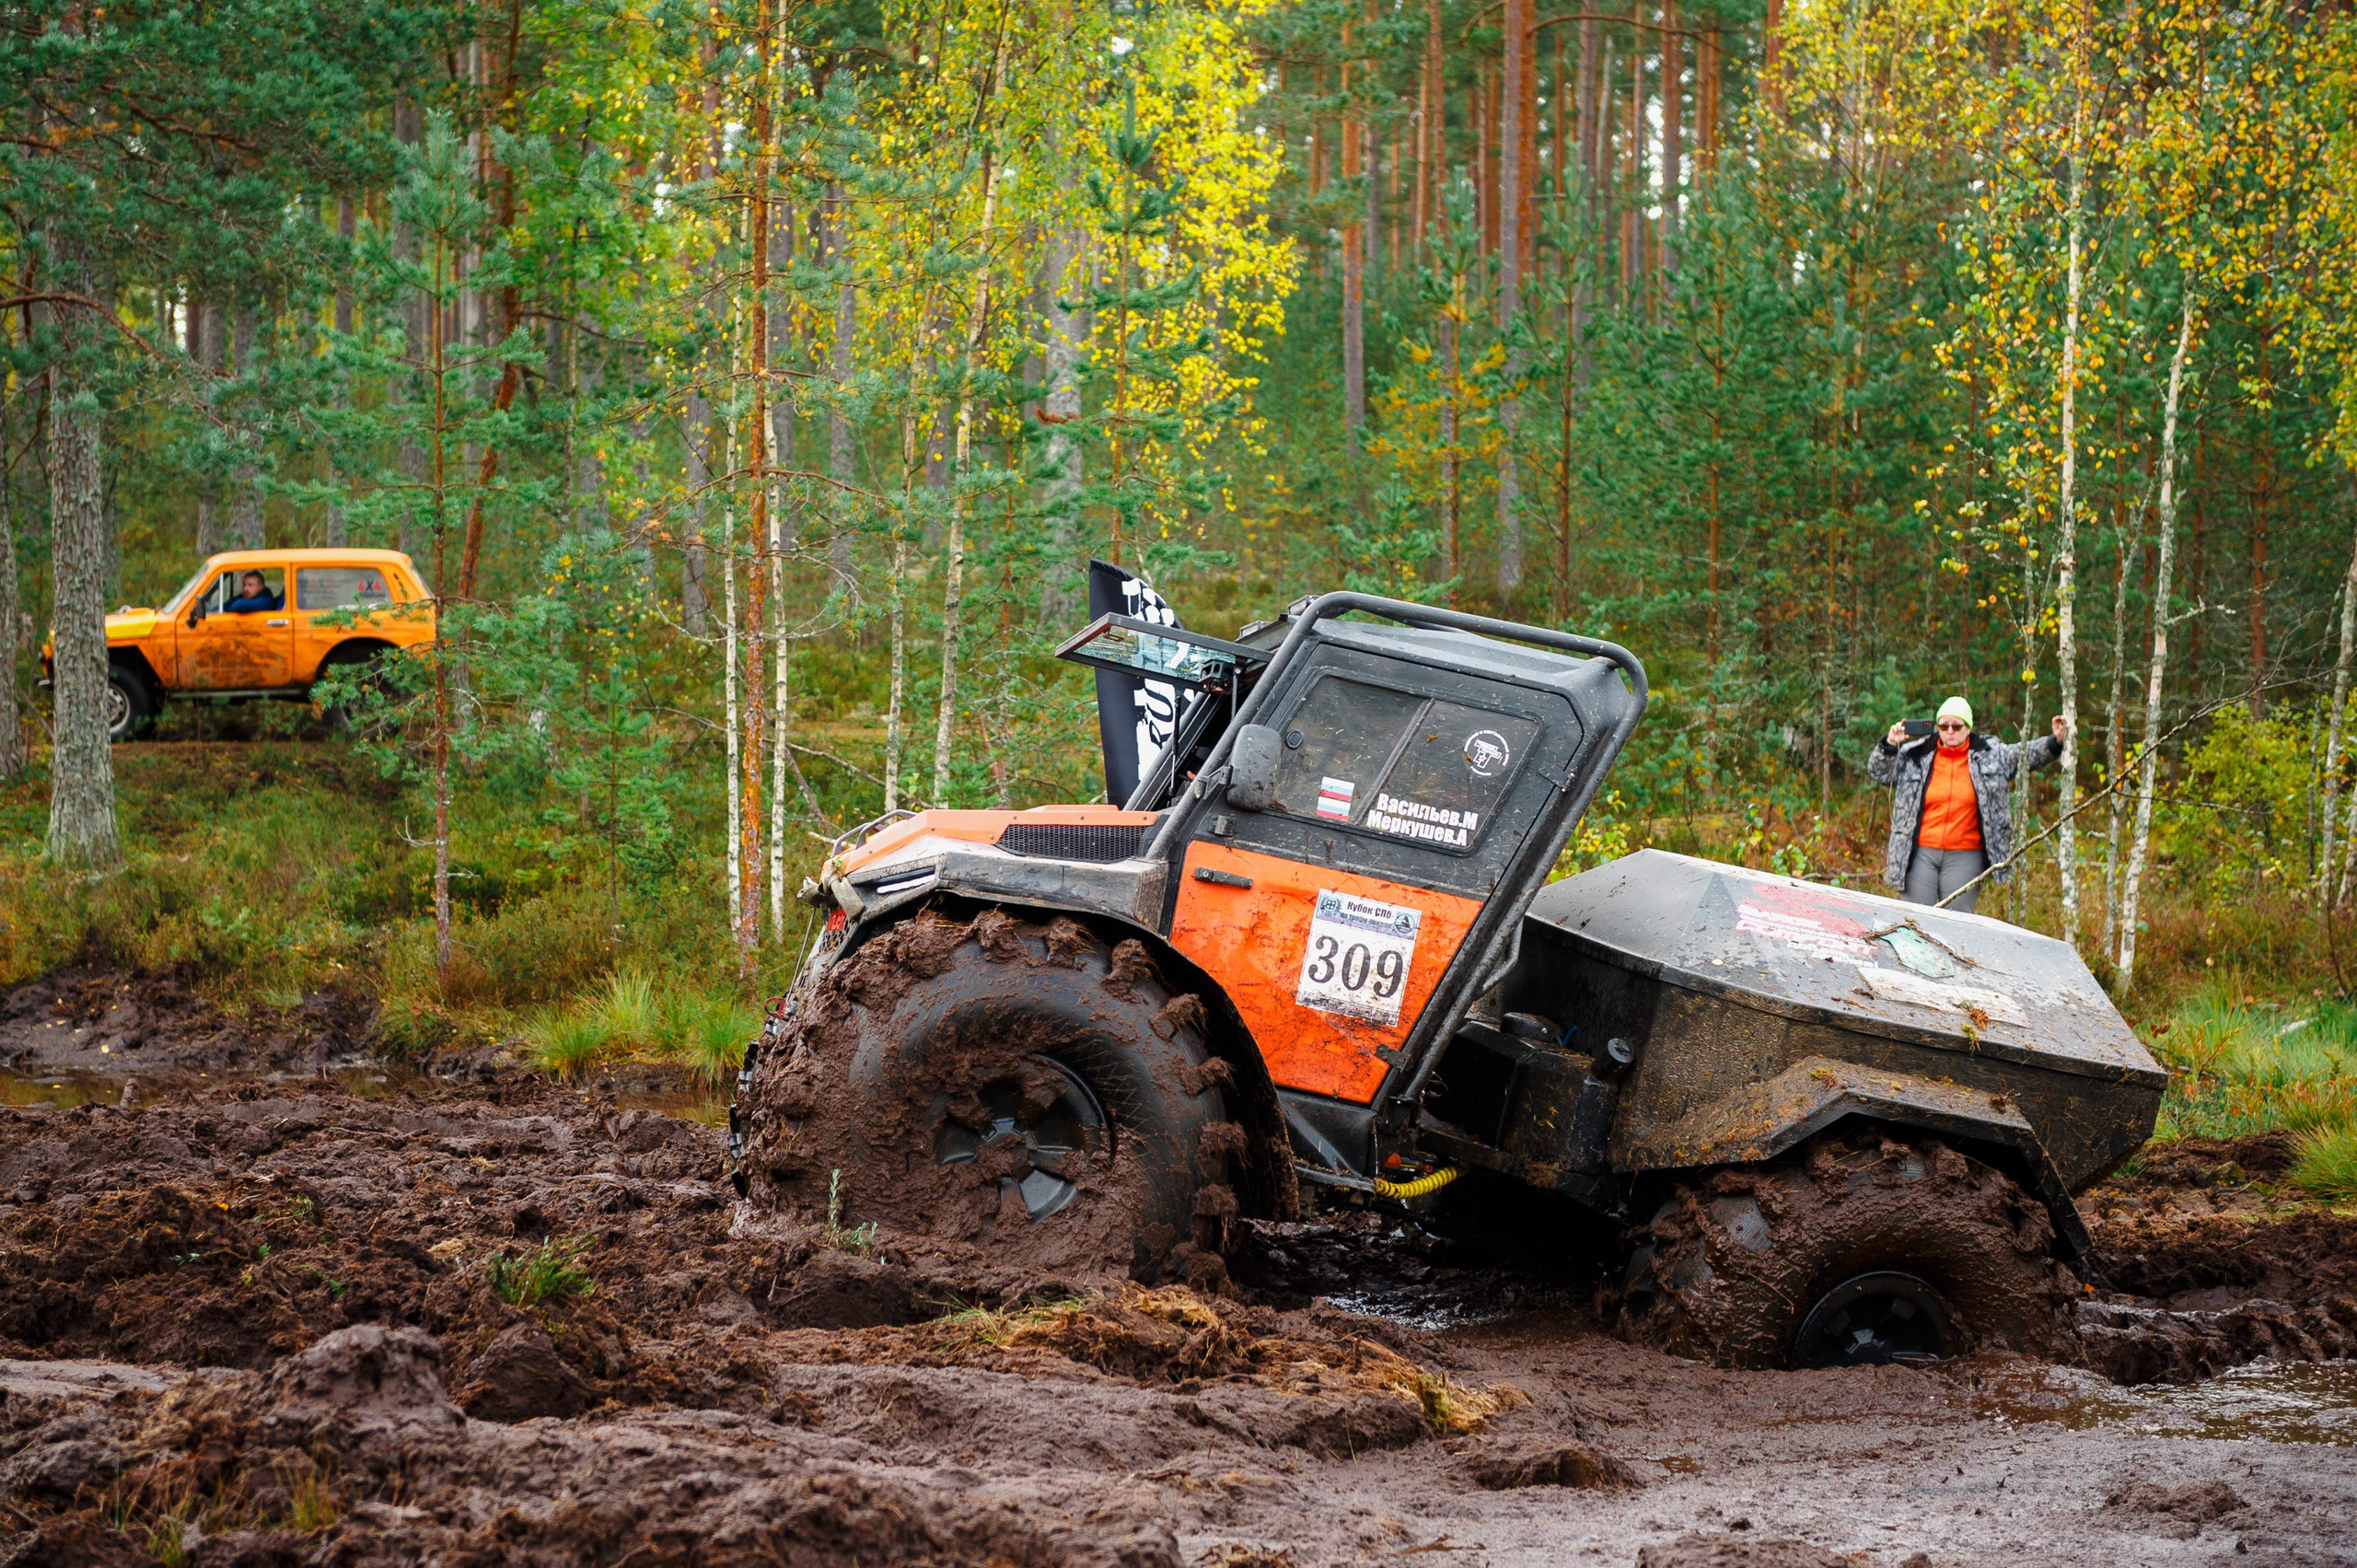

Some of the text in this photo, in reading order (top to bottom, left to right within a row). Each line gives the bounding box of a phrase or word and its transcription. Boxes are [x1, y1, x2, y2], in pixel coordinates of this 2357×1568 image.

[1366, 809, 1468, 846] Меркушев.А
[1376, 793, 1479, 830] Васильев.М
[1347, 901, 1373, 914] Кубок
[1307, 935, 1404, 998] 309
